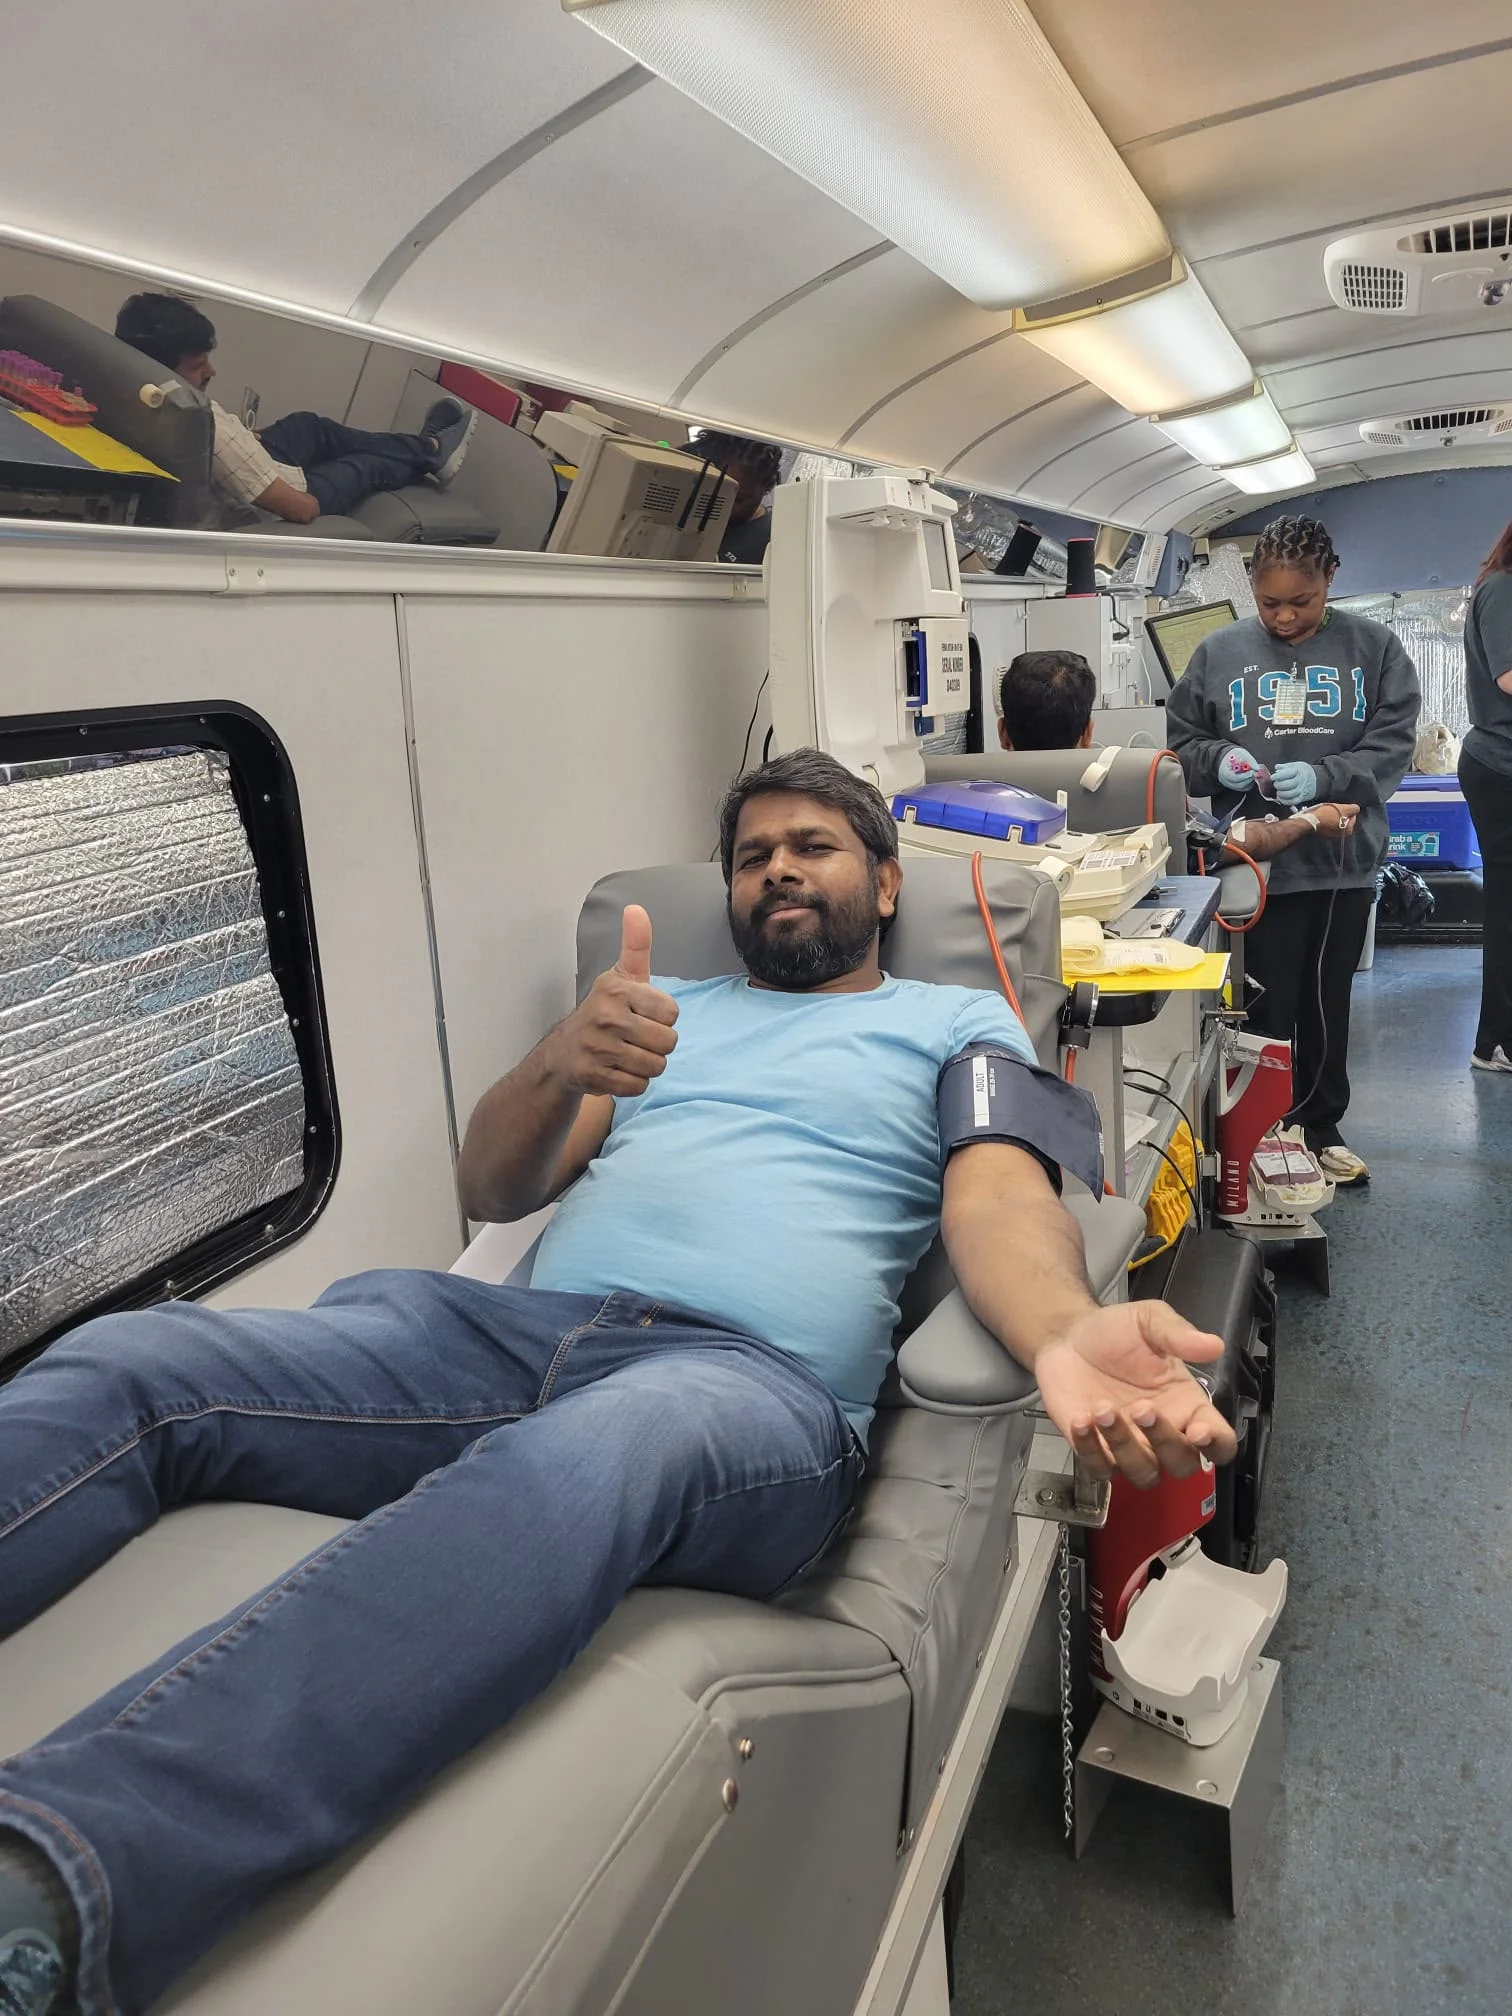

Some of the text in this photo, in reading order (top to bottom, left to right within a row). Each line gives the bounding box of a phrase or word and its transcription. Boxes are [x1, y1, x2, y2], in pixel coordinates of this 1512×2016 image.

[1243, 665, 1260, 673] EST.
[1229, 665, 1367, 731] 1951
[1274, 727, 1335, 736] Carter BloodCare
[1388, 843, 1406, 851] rink
[975, 1072, 984, 1092] ADULT
[1226, 1160, 1240, 1207] MILANO
